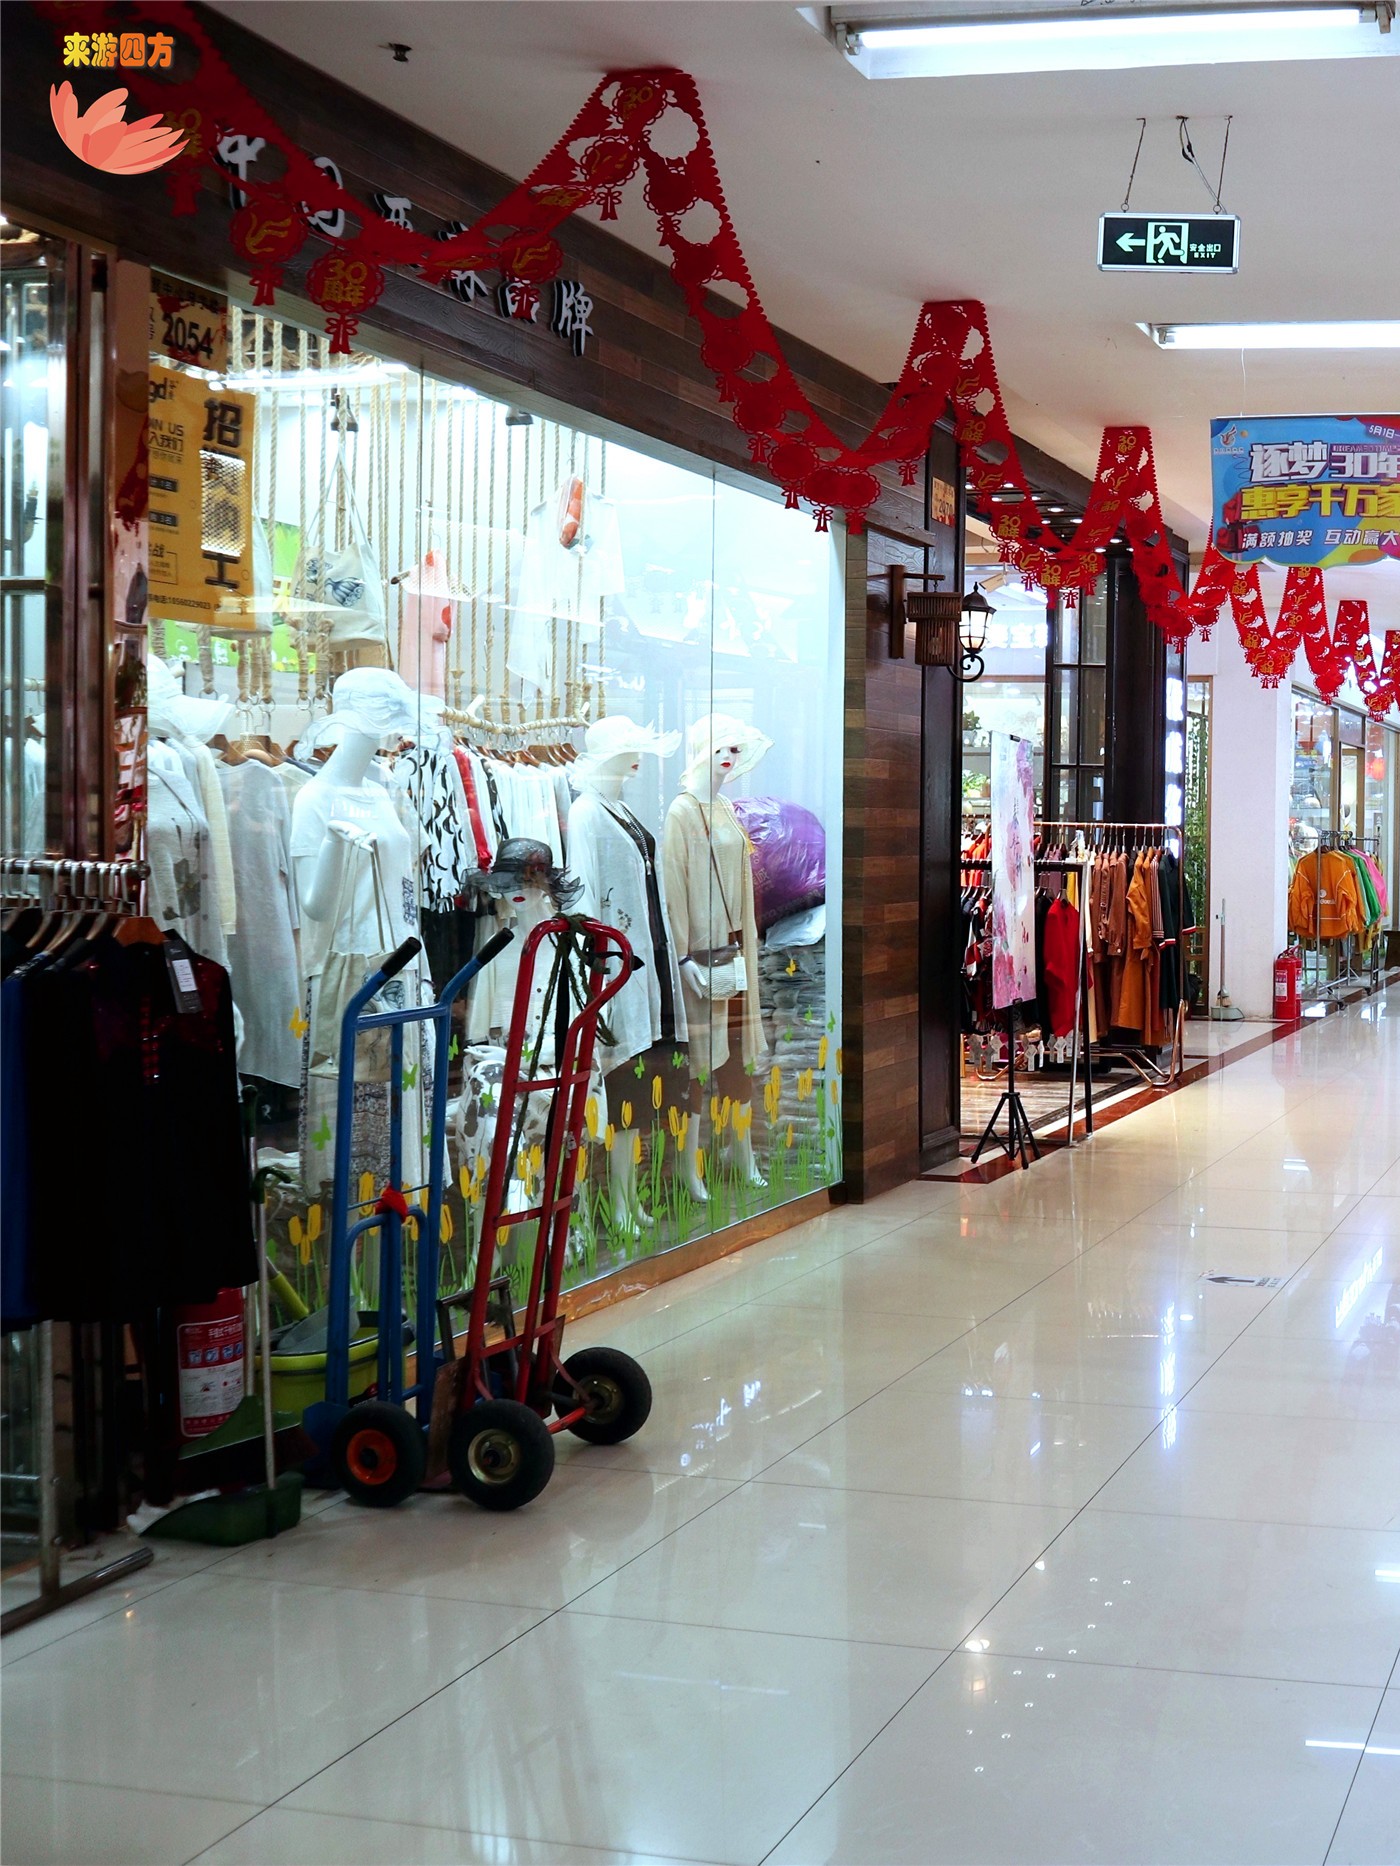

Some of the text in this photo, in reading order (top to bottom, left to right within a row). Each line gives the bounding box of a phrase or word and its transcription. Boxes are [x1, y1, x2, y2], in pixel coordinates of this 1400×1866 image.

[1189, 243, 1221, 253] 安全出口
[326, 259, 367, 284] 30
[321, 282, 367, 307] 周年
[162, 312, 213, 360] 2054
[168, 422, 184, 437] US
[1000, 515, 1021, 527] 30
[1242, 530, 1313, 549] 满额抽奖
[1042, 564, 1062, 576] 30
